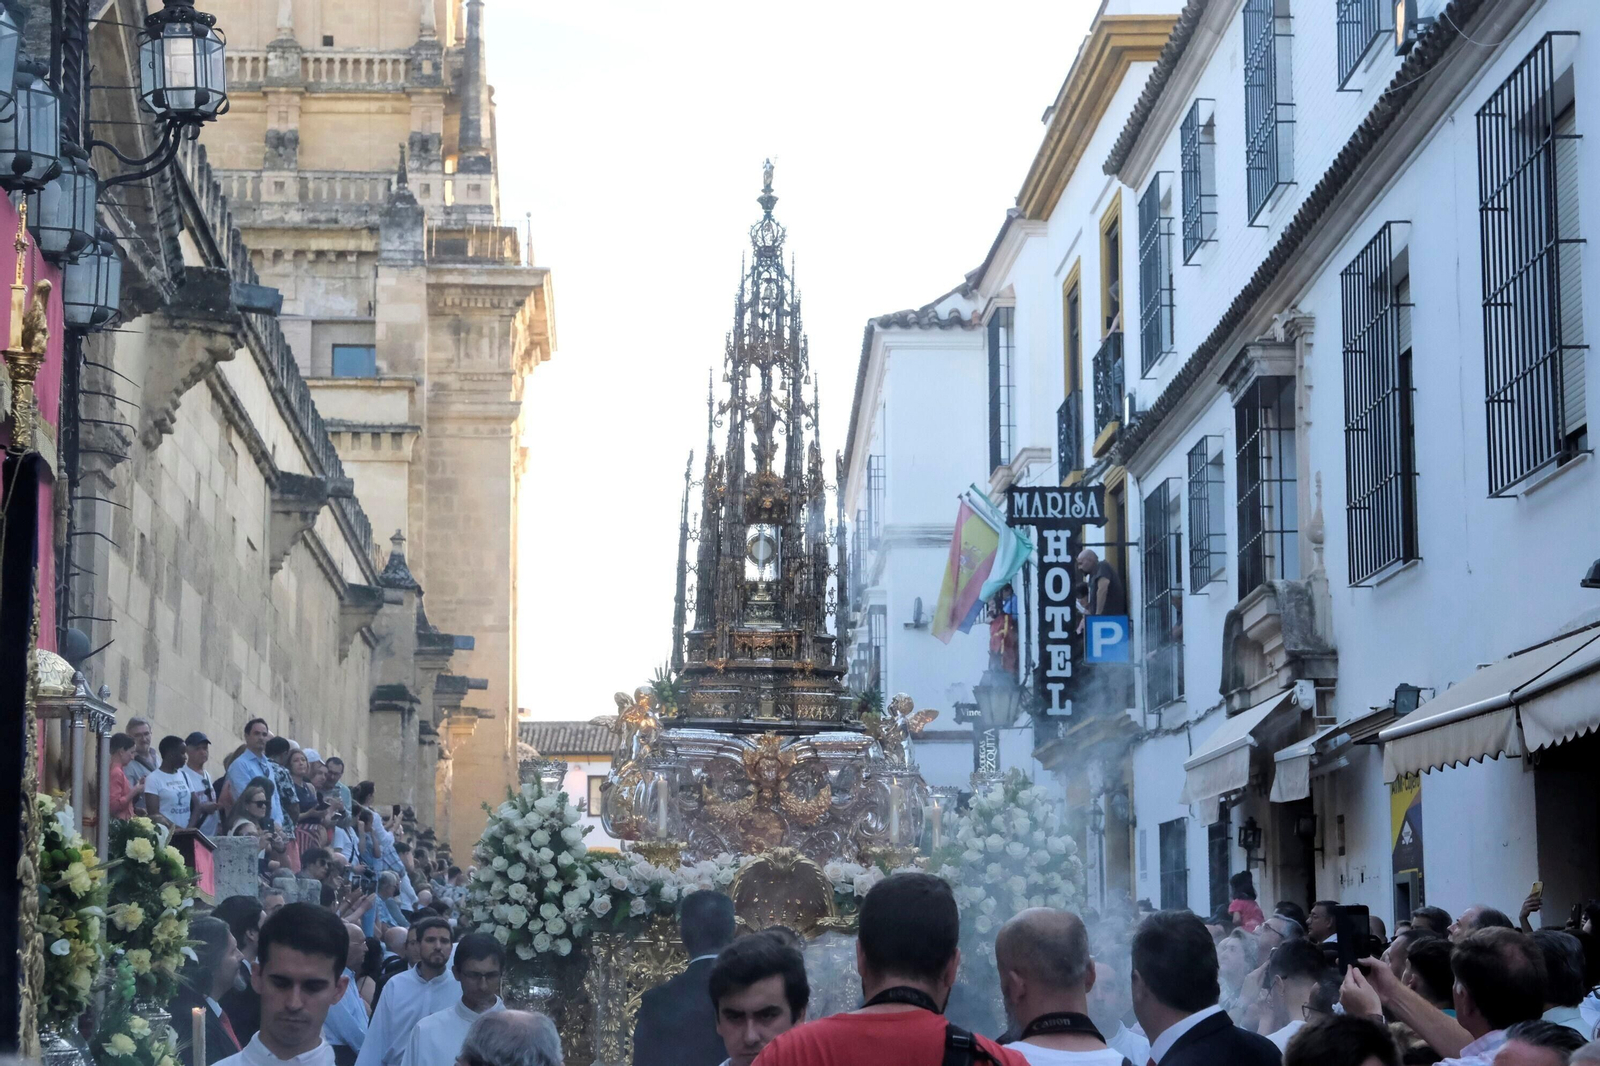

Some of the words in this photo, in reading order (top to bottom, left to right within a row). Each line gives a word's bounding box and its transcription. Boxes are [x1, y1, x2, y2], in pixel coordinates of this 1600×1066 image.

[1012, 491, 1100, 519] MARISA
[1042, 529, 1072, 716] HOTEL
[1092, 621, 1123, 658] P
[983, 728, 997, 774] EZQUITA
[1032, 1018, 1071, 1030] Canon
